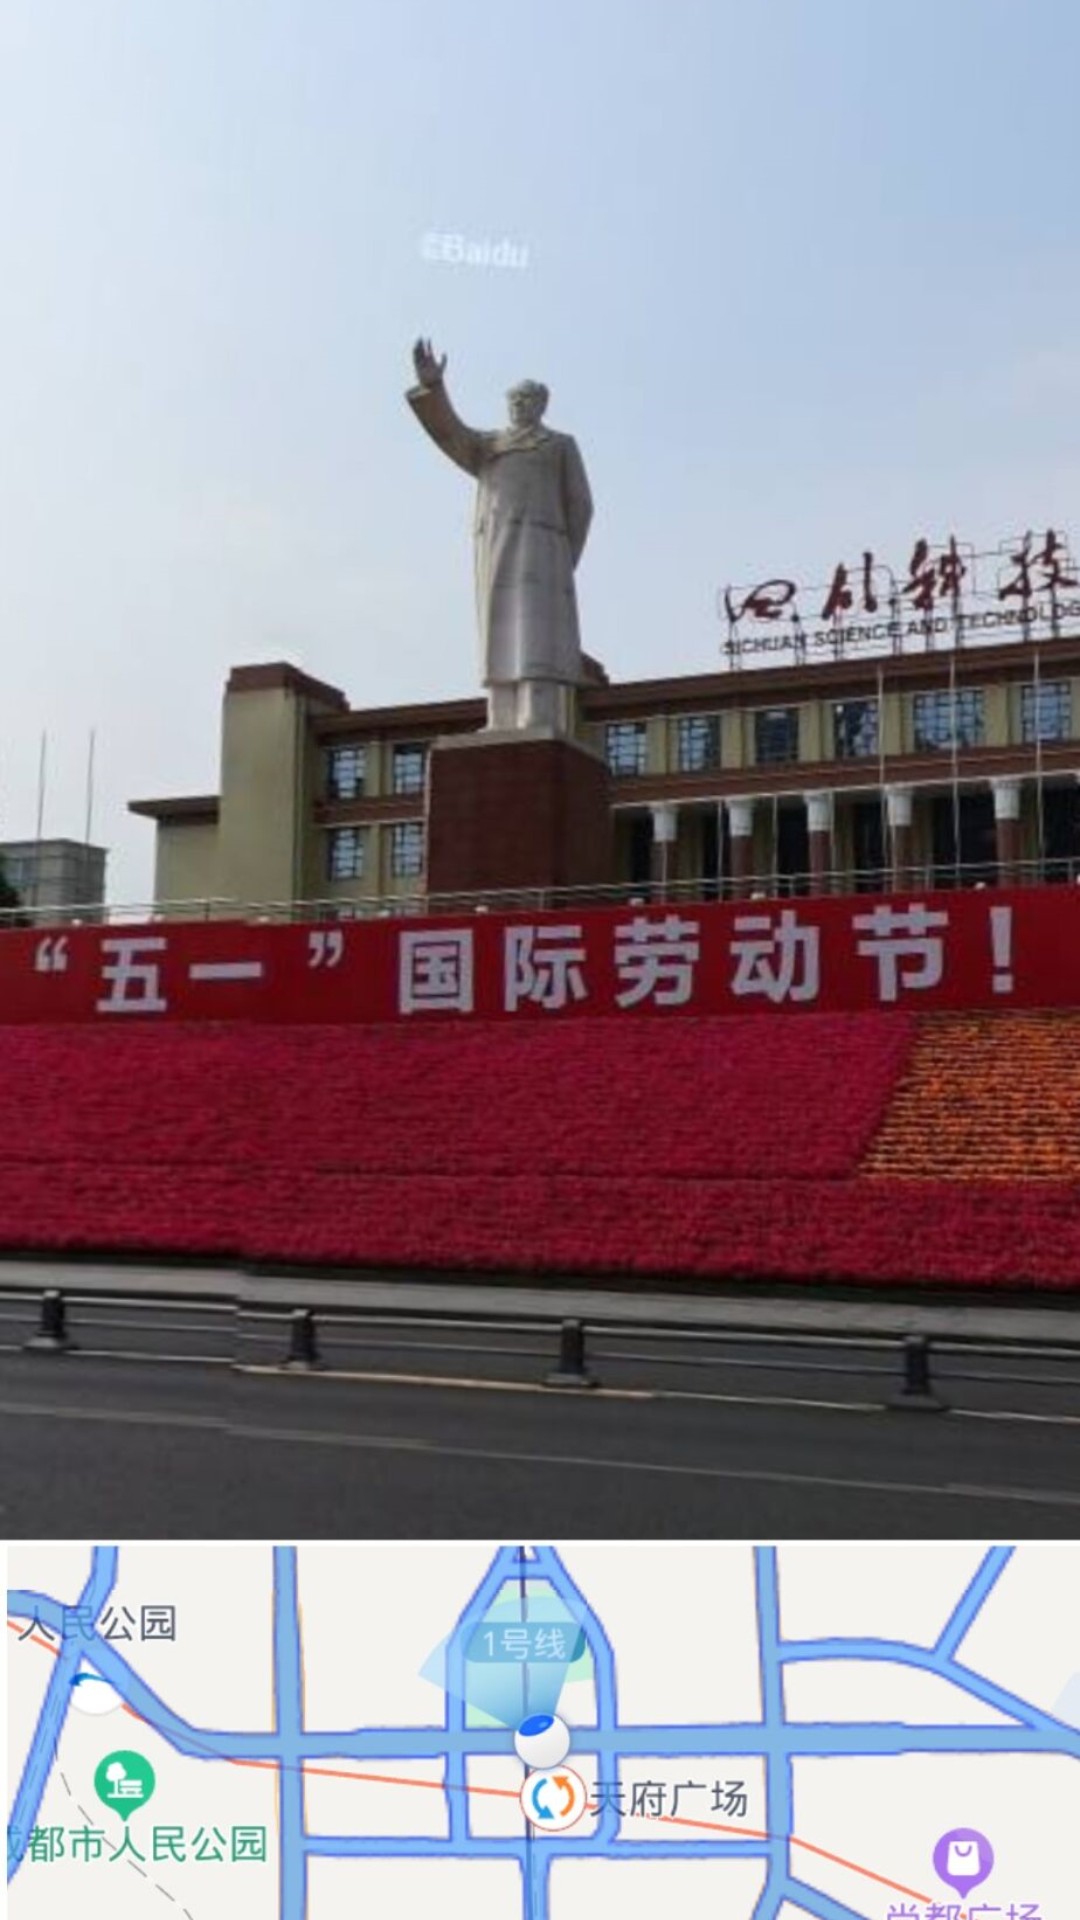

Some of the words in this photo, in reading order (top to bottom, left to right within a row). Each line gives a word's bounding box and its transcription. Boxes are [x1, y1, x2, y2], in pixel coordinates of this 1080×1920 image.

[724, 528, 1079, 622] 四川科技
[725, 631, 806, 655] SICHUAN
[815, 621, 900, 647] SCIENCE
[907, 615, 948, 636] AND
